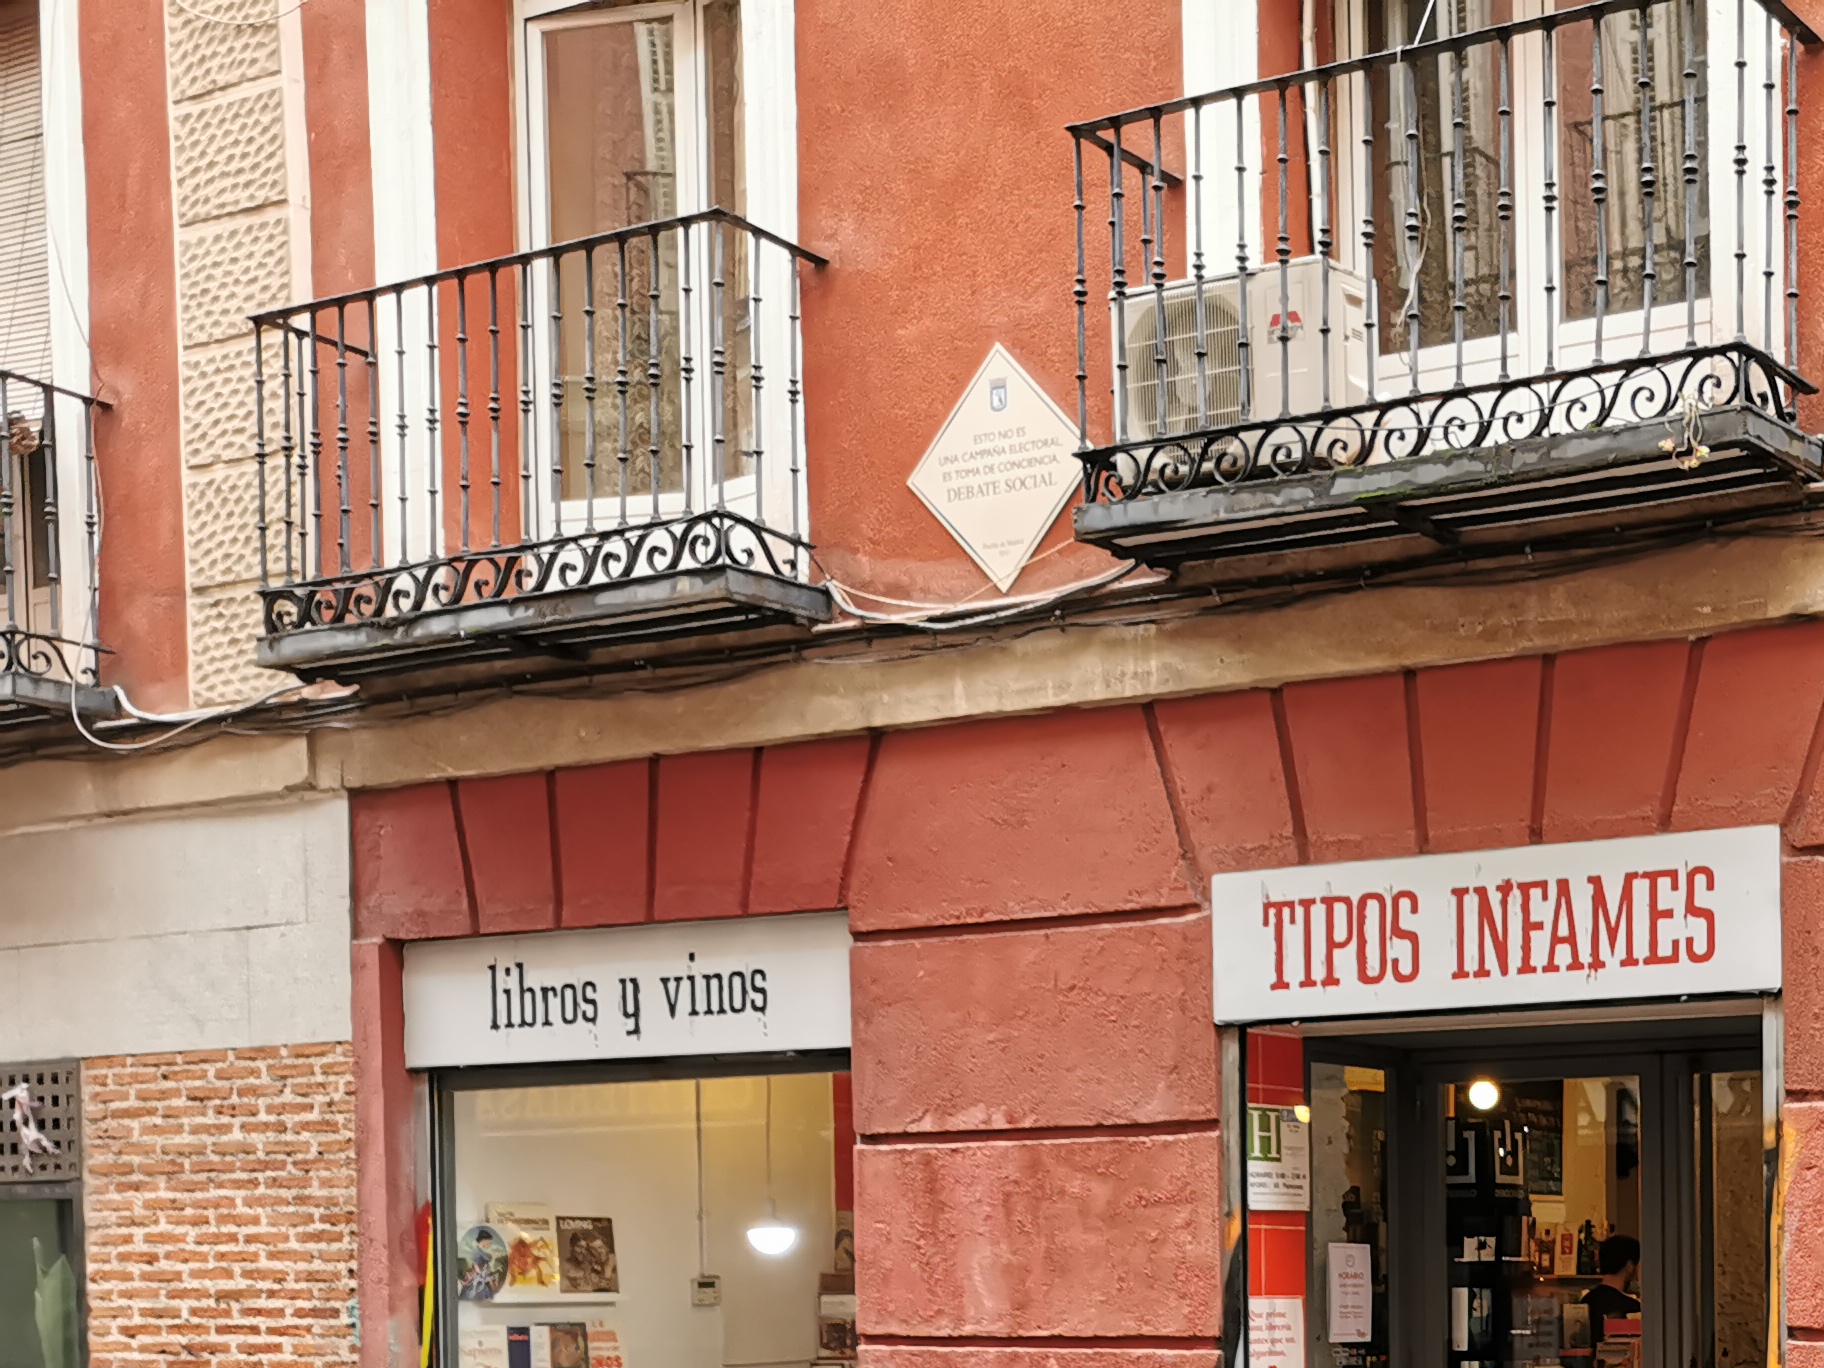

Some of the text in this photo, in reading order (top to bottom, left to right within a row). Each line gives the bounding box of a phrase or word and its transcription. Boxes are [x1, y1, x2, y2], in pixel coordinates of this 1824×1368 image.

[998, 428, 1015, 442] NO
[947, 471, 1058, 504] DEBATE SOCIAL
[1261, 864, 1717, 991] TIPOS INFAMES
[487, 952, 770, 1038] libros y vinos
